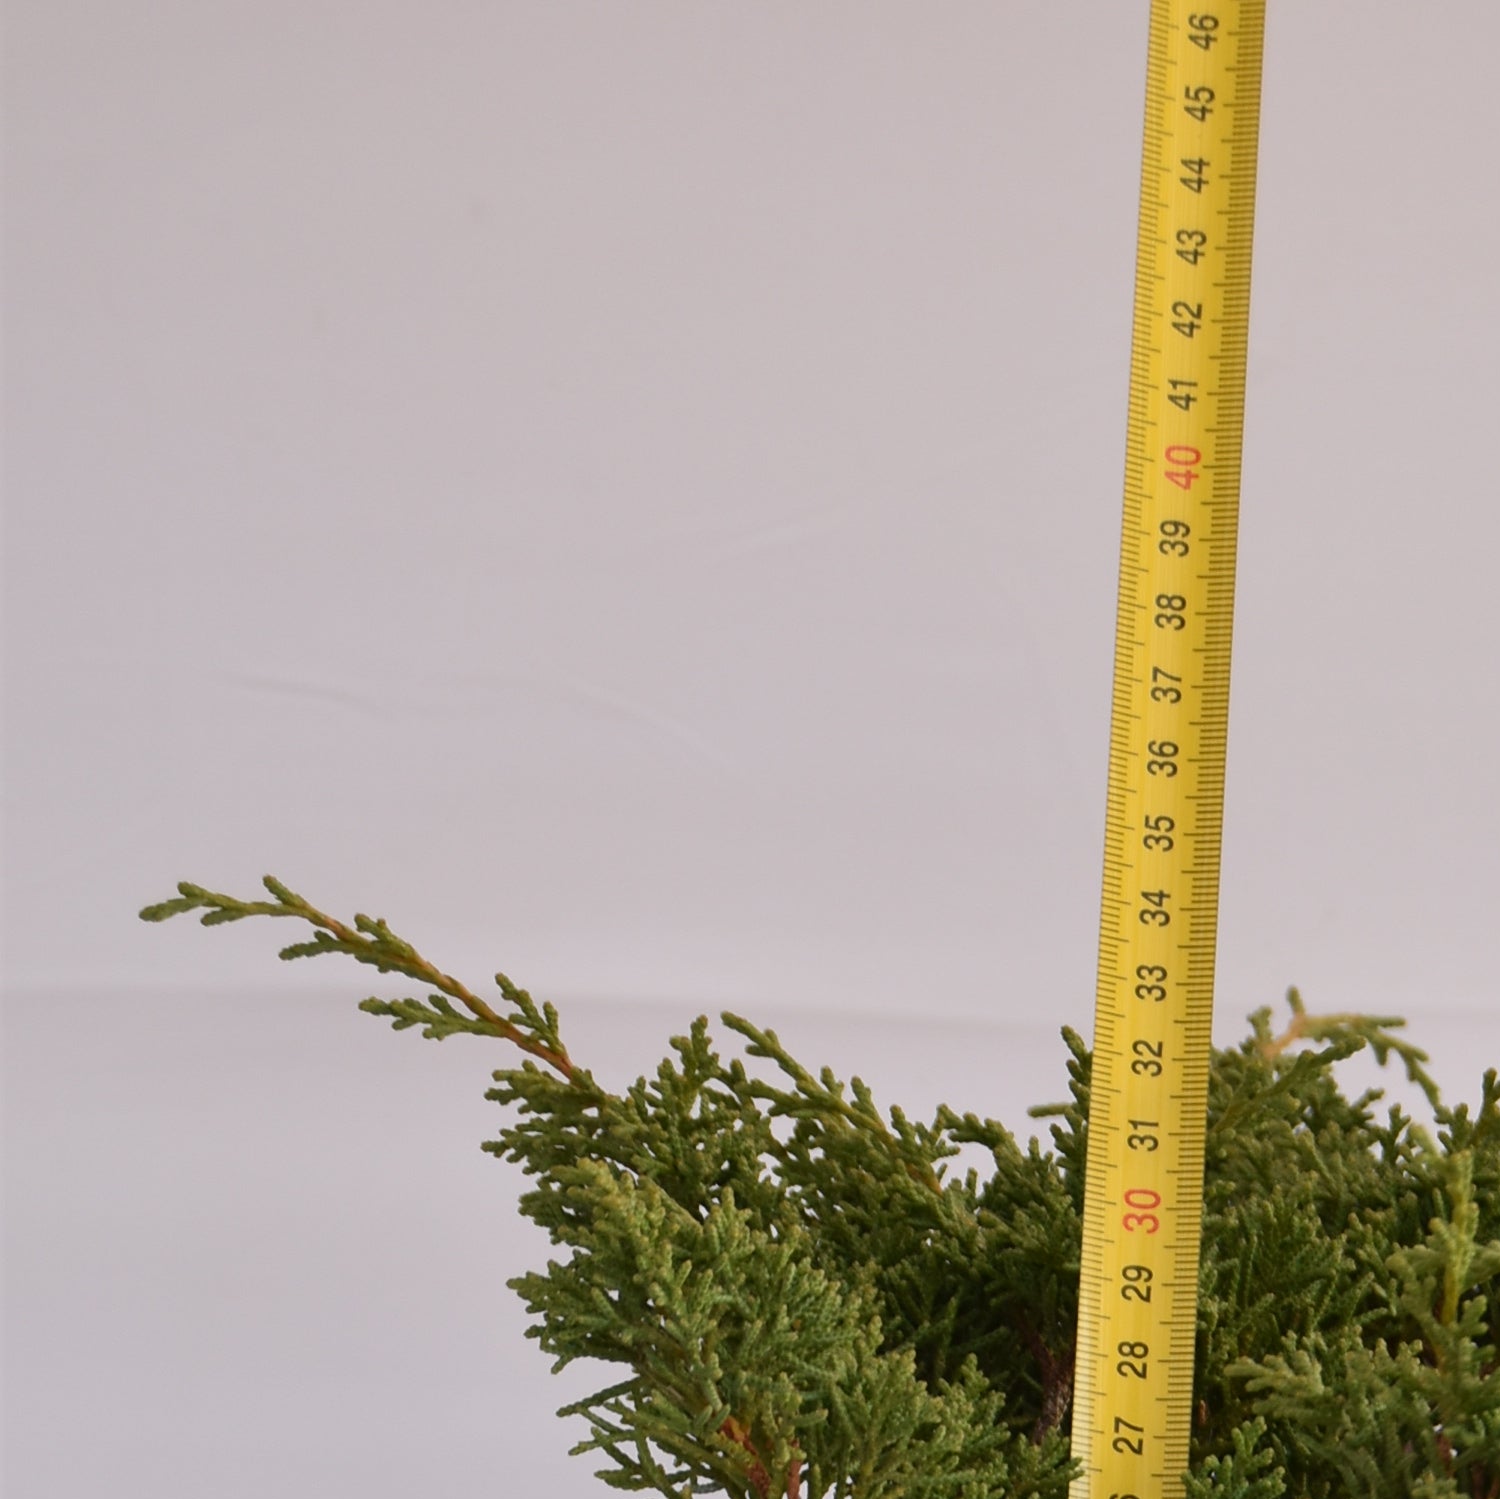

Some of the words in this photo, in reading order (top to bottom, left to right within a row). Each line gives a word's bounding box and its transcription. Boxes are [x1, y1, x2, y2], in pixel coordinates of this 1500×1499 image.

[1188, 15, 1219, 50] 46
[1184, 86, 1215, 122] 45
[1180, 158, 1210, 193] 44
[1176, 230, 1207, 265] 43
[1172, 302, 1202, 338] 42
[1168, 380, 1197, 410] 41
[1165, 446, 1201, 489] 40
[1159, 520, 1190, 557] 39
[1155, 594, 1186, 630] 38
[1151, 667, 1182, 704] 37
[1147, 741, 1179, 777] 36
[1143, 815, 1175, 852] 35
[1139, 890, 1171, 926] 34
[1135, 965, 1167, 1002] 33
[1131, 1040, 1163, 1077] 32
[1127, 1120, 1159, 1151] 31
[1123, 1190, 1161, 1234] 30
[1121, 1265, 1153, 1303] 29
[1117, 1342, 1149, 1379] 28
[1112, 1417, 1144, 1455] 27
